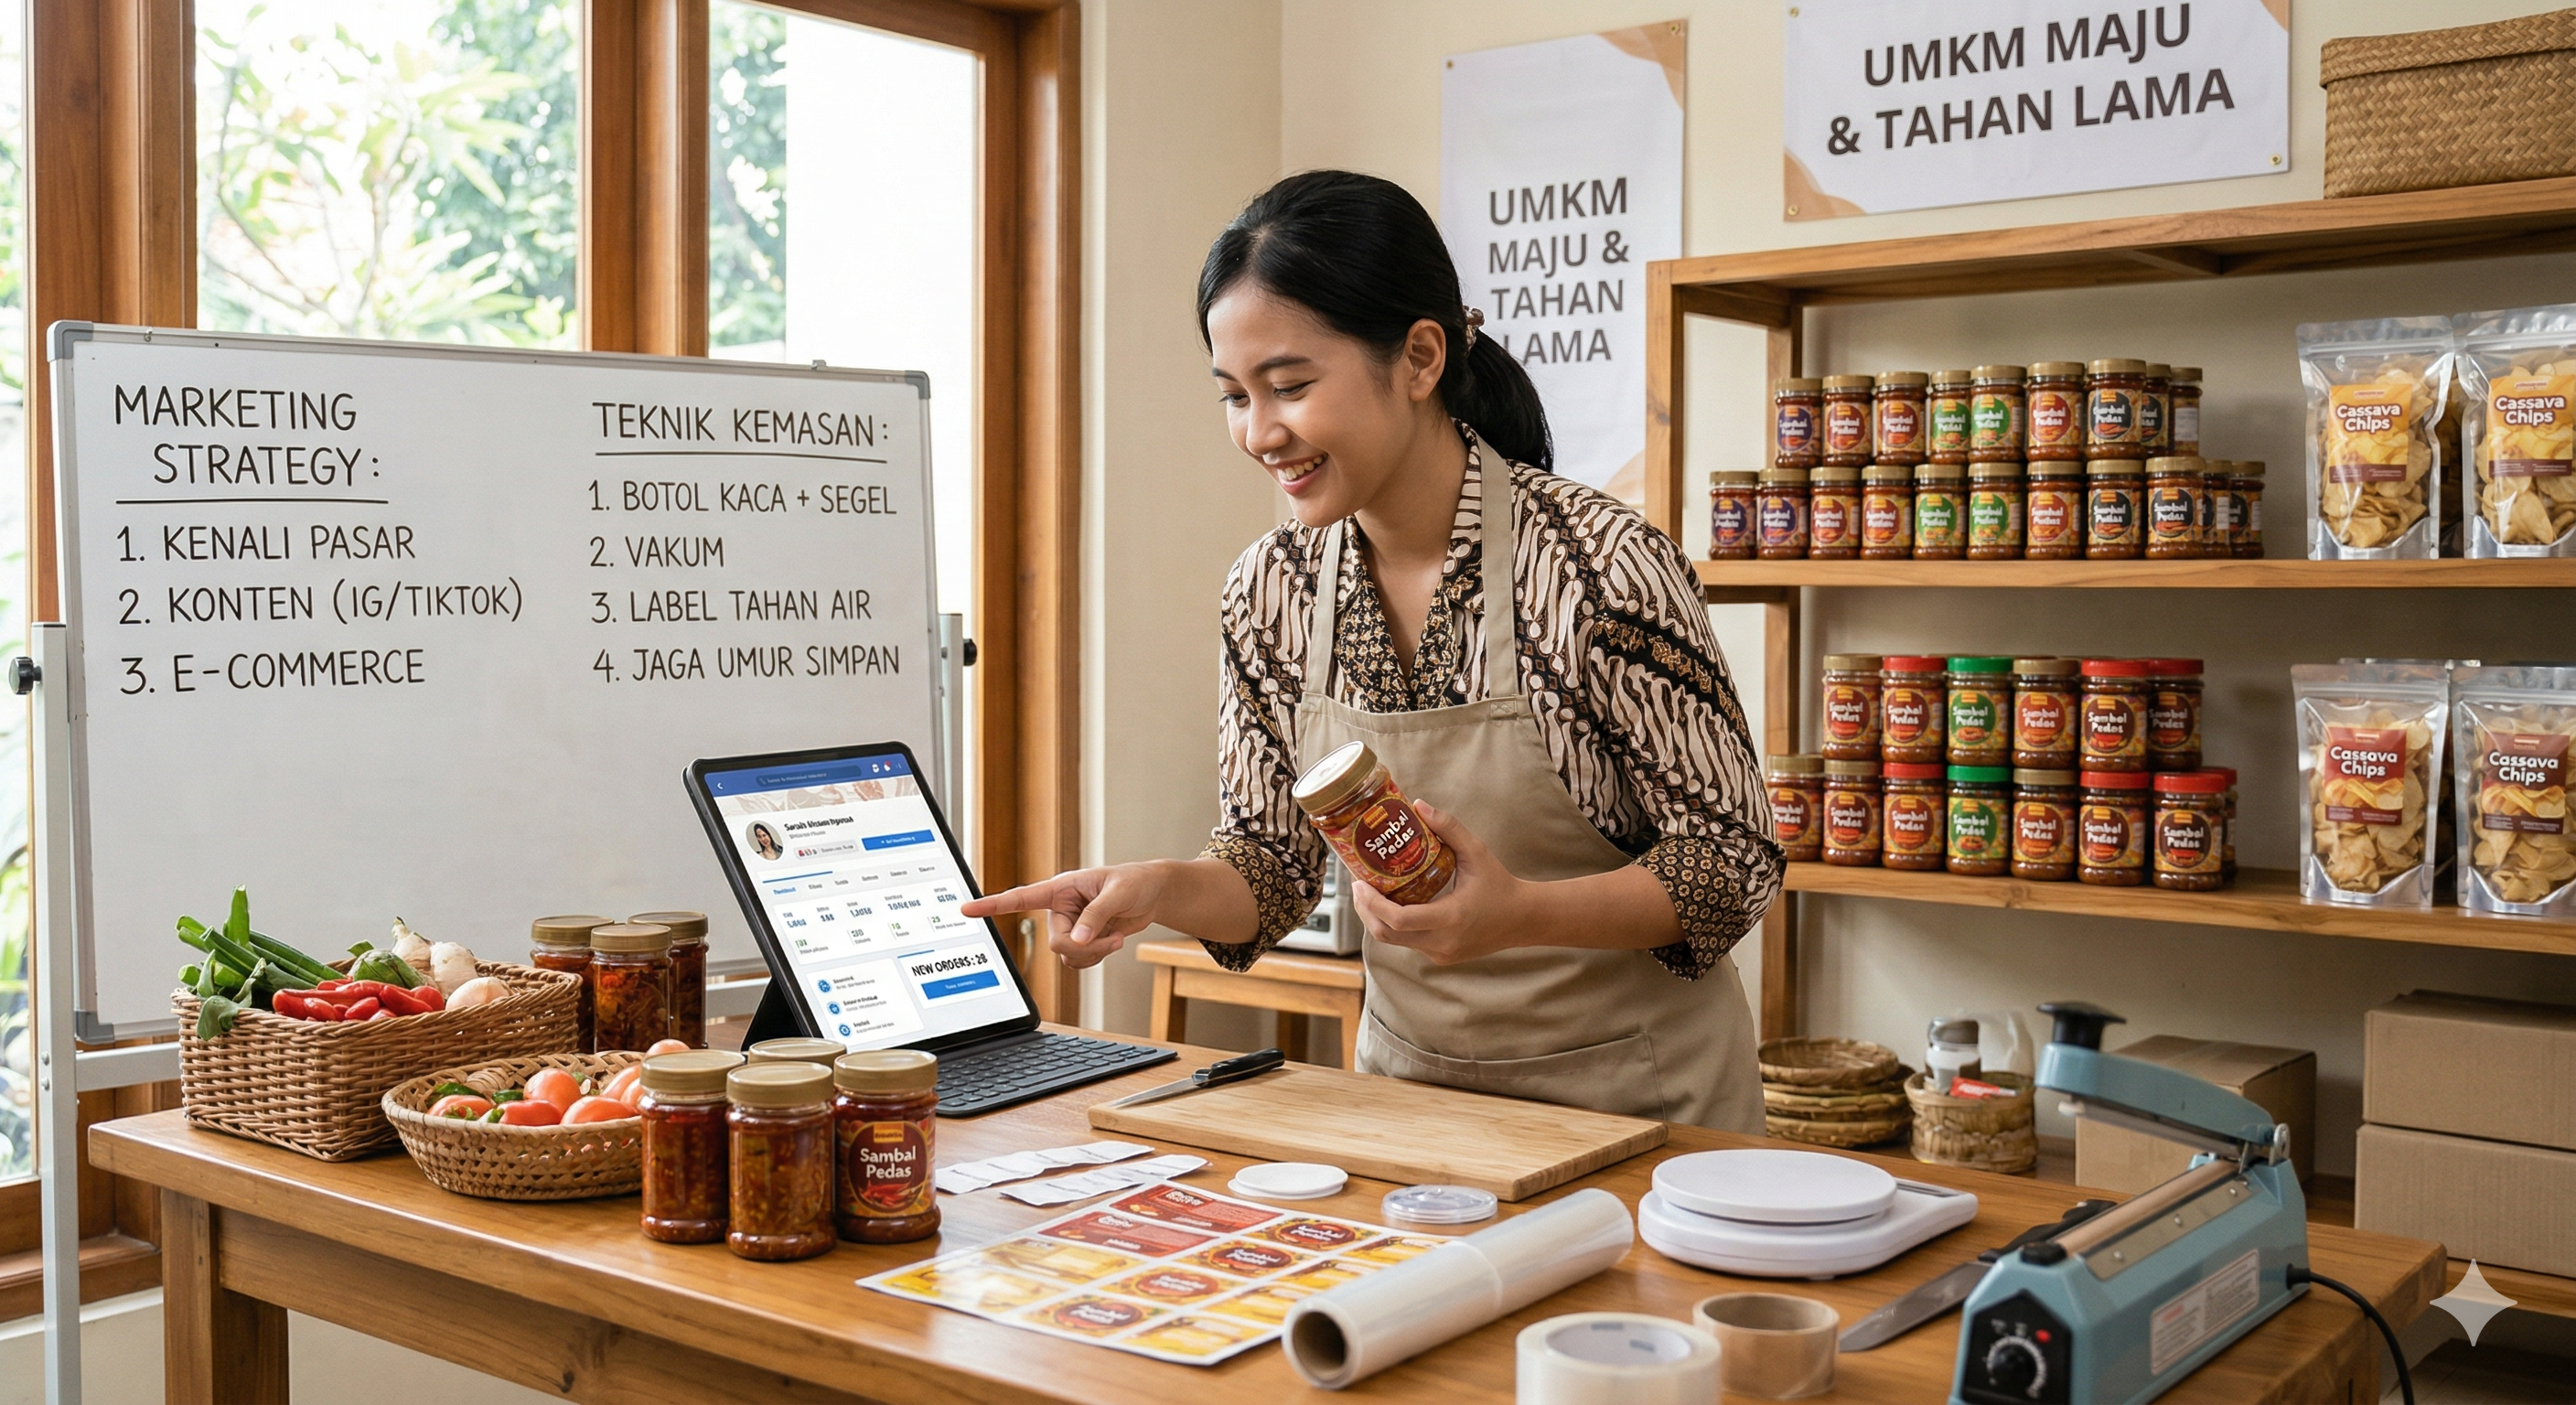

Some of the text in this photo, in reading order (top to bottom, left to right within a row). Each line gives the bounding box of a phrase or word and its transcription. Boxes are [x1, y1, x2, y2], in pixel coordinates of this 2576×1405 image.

[1865, 3, 2190, 87] UMKM MAJU
[1828, 69, 2235, 156] & TAHAN LAMA
[1490, 177, 1626, 225] UMKM
[1489, 231, 1629, 278] MAJU &
[1491, 279, 1623, 320] TAHAN
[115, 384, 356, 431] MARKETING
[2336, 403, 2401, 419] Cassava
[2496, 395, 2565, 411] Cassava
[2506, 409, 2554, 425] Chips
[592, 402, 715, 441] TEKNIK
[2345, 415, 2390, 431] Chips
[589, 480, 896, 514] 1. BOTOL KACA + SEGEL
[117, 525, 415, 562] 1. KENALI PASAR
[590, 536, 724, 567] 2. VAKUM
[119, 577, 521, 624] 2. KONTEN (IG/TIKTOK)
[592, 590, 872, 623] 3. LABEL TAHAN AIR
[121, 649, 424, 694] 3. E-COMMERCE
[593, 645, 899, 683] 4. JAGA UMUR SIMPAN
[2088, 712, 2127, 724] Sambal
[2091, 722, 2124, 734] Pedas
[2330, 746, 2398, 764] Cassava
[2340, 760, 2386, 778] Chips
[2489, 752, 2559, 769] Cassava
[2498, 767, 2546, 786] Chips
[911, 963, 934, 977] NEW
[860, 1145, 916, 1163] Sambal
[866, 1163, 912, 1179] Pedas
